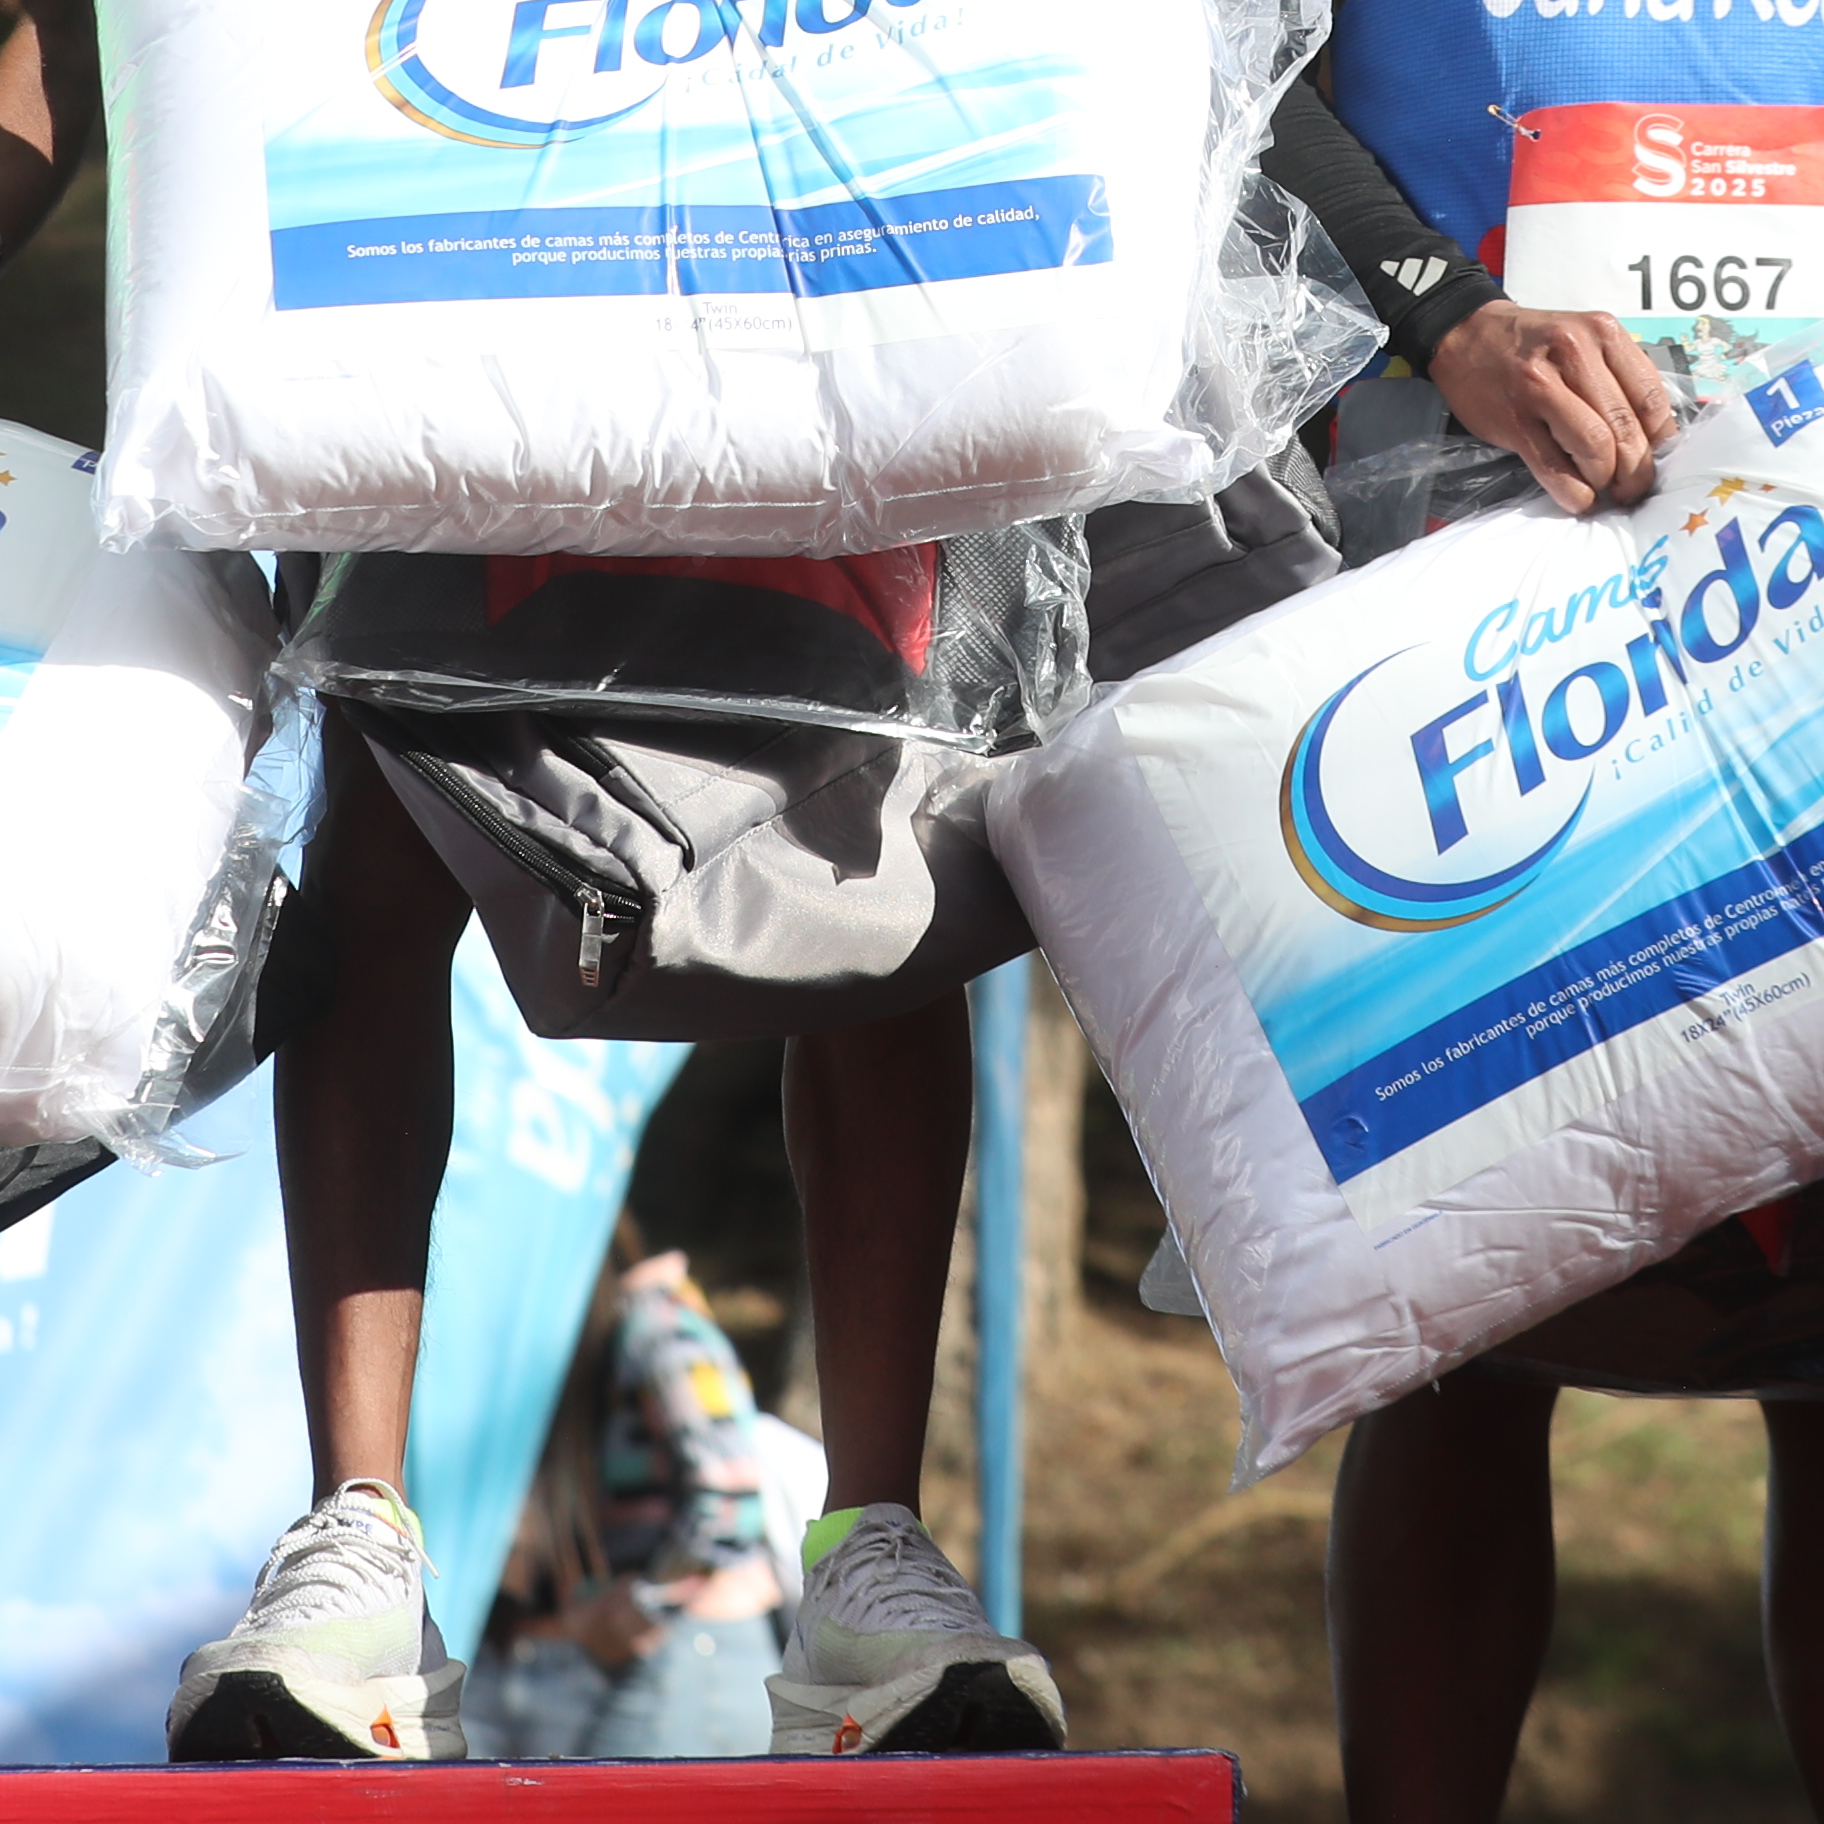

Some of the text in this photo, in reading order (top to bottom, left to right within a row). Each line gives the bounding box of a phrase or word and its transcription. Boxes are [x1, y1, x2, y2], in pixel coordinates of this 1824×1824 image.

[816, 43, 855, 67] de
[875, 8, 965, 49] Vida!
[1690, 141, 1752, 159] Carrera
[1690, 159, 1796, 177] San Silvestre
[1689, 178, 1767, 198] 2025
[346, 243, 397, 259] Somos
[401, 241, 424, 255] los
[428, 235, 517, 253] fabricantes
[520, 233, 541, 248] de
[544, 235, 594, 248] camas
[598, 231, 631, 247] más
[714, 230, 734, 245] de
[738, 229, 811, 250] Centrica
[814, 233, 833, 246] en
[838, 216, 949, 244] aseguramiento
[953, 213, 973, 228] de
[977, 205, 1041, 226] calidad,
[512, 248, 566, 266] porque
[572, 245, 661, 265] producimos
[820, 241, 878, 263] primas.
[1627, 253, 1794, 312] 1667
[702, 302, 737, 315] Twin
[1766, 377, 1801, 410] 1
[1611, 688, 1714, 780] ¡Calid
[1729, 660, 1764, 693] de
[1525, 1002, 1576, 1039] porque
[1578, 962, 1661, 1010] producimos
[1662, 931, 1723, 967] nuestras
[1724, 903, 1778, 940] propias
[1375, 1069, 1422, 1102] Somos
[1421, 1057, 1445, 1075] los
[1445, 1011, 1527, 1062] fabricantes
[1527, 996, 1547, 1018] de
[1549, 976, 1595, 1007] camas
[1596, 960, 1627, 983] más
[1628, 923, 1702, 967] completos
[1704, 911, 1723, 931] de
[1719, 982, 1756, 1006] Twin
